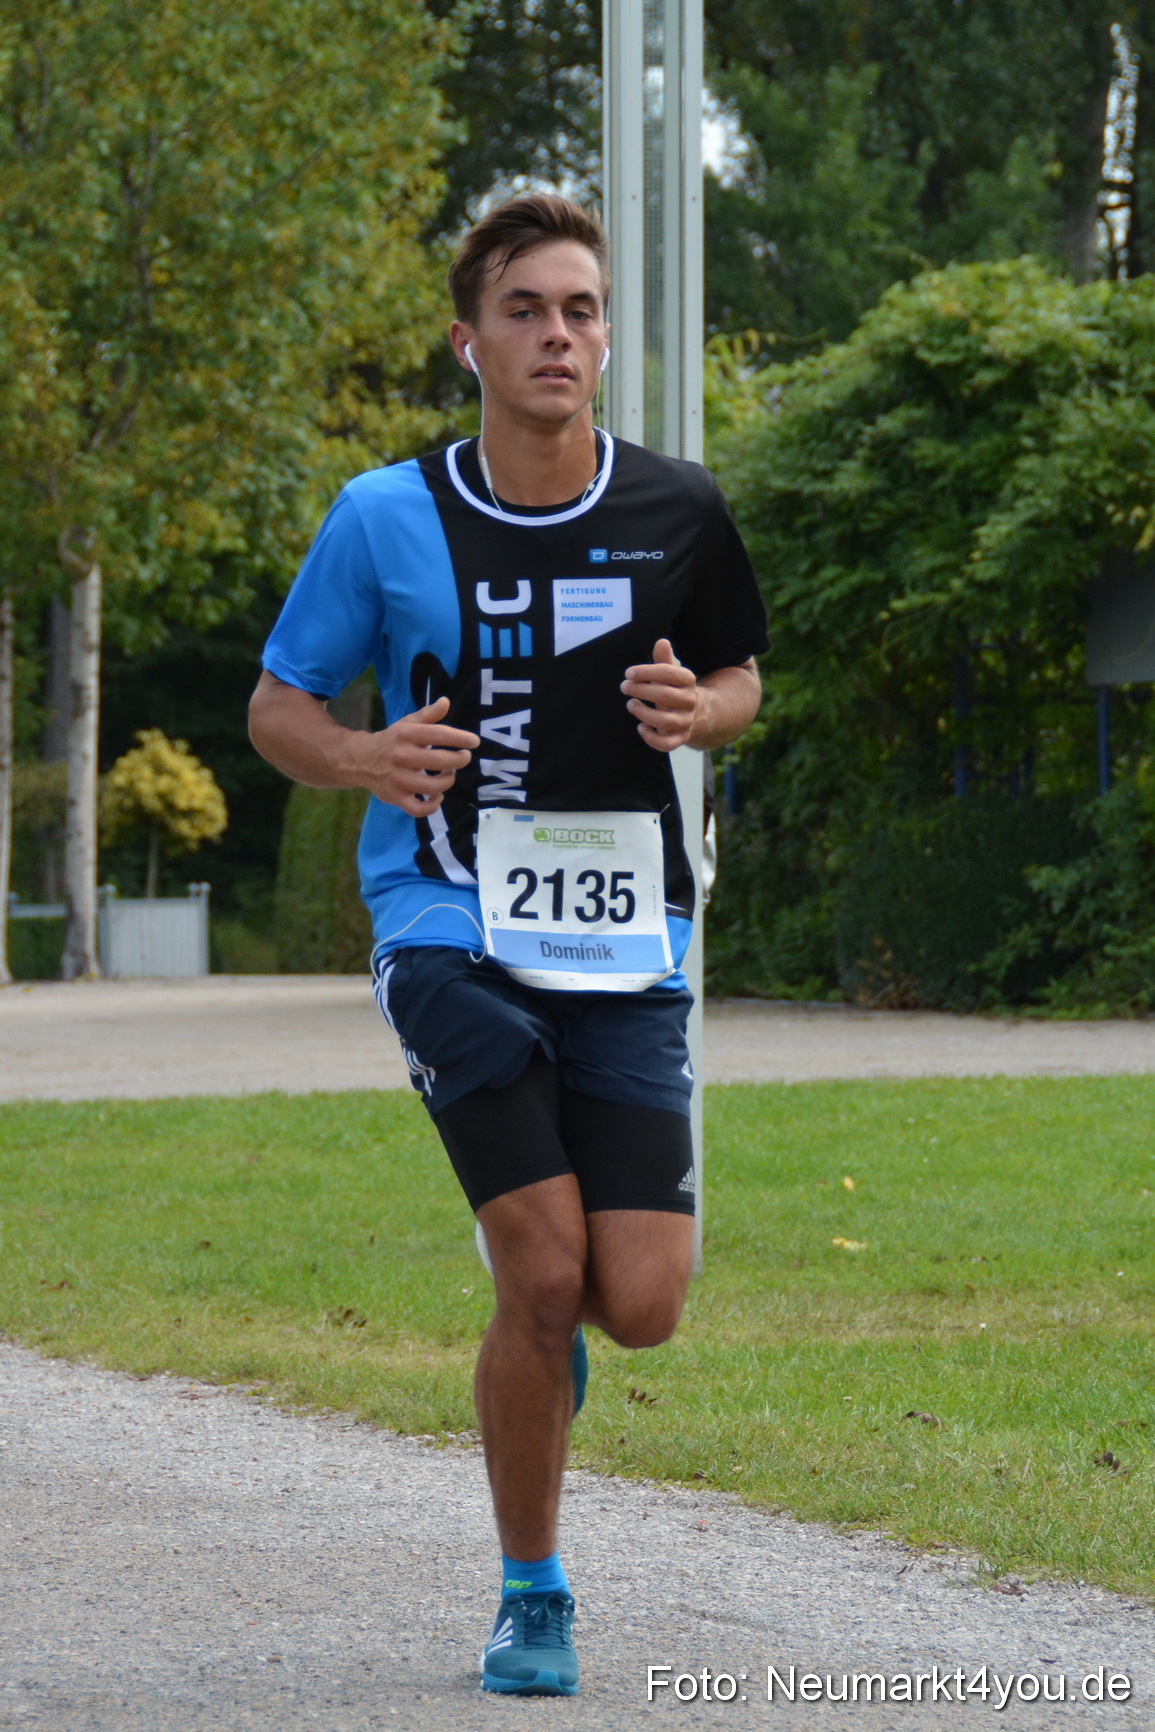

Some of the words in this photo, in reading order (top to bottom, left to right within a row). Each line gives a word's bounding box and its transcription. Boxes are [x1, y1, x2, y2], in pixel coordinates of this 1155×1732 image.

[560, 587, 607, 595] FERTIGUNG
[561, 601, 614, 609] MASCHINENBAU
[561, 615, 603, 623] FORMENBAU
[473, 579, 533, 870] MATEC
[553, 828, 616, 845] BOCK
[506, 866, 636, 924] 2135
[492, 911, 499, 921] B
[539, 940, 615, 961] Dominik
